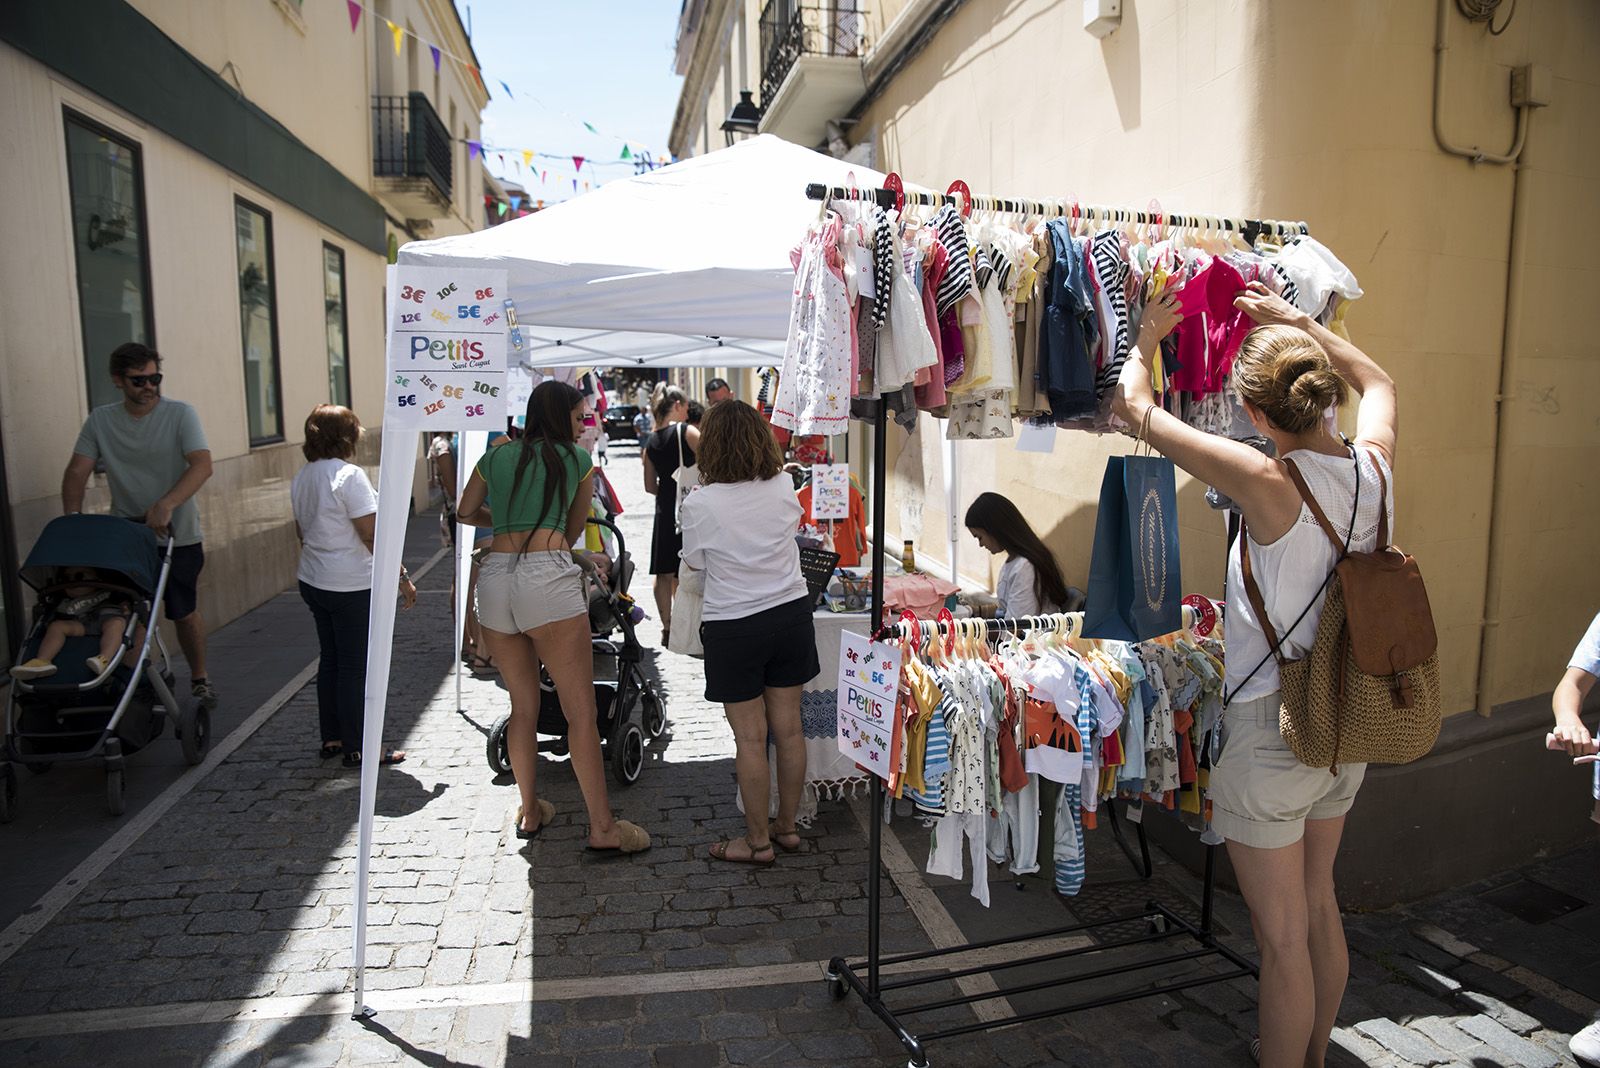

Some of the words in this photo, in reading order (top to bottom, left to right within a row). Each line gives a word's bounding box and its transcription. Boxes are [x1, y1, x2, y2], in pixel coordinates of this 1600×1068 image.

[401, 285, 426, 303] 3€
[436, 283, 458, 300] 10€
[475, 287, 494, 300] 8€
[401, 313, 421, 323] 12€
[458, 305, 480, 318] 5€
[483, 312, 500, 326] 20€
[411, 336, 484, 361] Petits
[470, 360, 490, 368] Cugat
[395, 376, 410, 387] 3€
[420, 375, 438, 391] 15€
[443, 385, 464, 399] 8€
[472, 381, 500, 397] 10€
[398, 395, 416, 407] 5€
[424, 400, 446, 415] 12€
[465, 404, 484, 417] 3€
[846, 648, 858, 663] 3€
[863, 652, 874, 664] 10€
[882, 661, 892, 670] 8€
[846, 669, 855, 677] 12€
[872, 671, 884, 684] 5€
[848, 688, 882, 718] Petits
[842, 729, 850, 739] 5€
[860, 731, 870, 744] 8€
[853, 740, 862, 749] 12€
[874, 734, 887, 751] 10€
[870, 750, 879, 762] 3€
